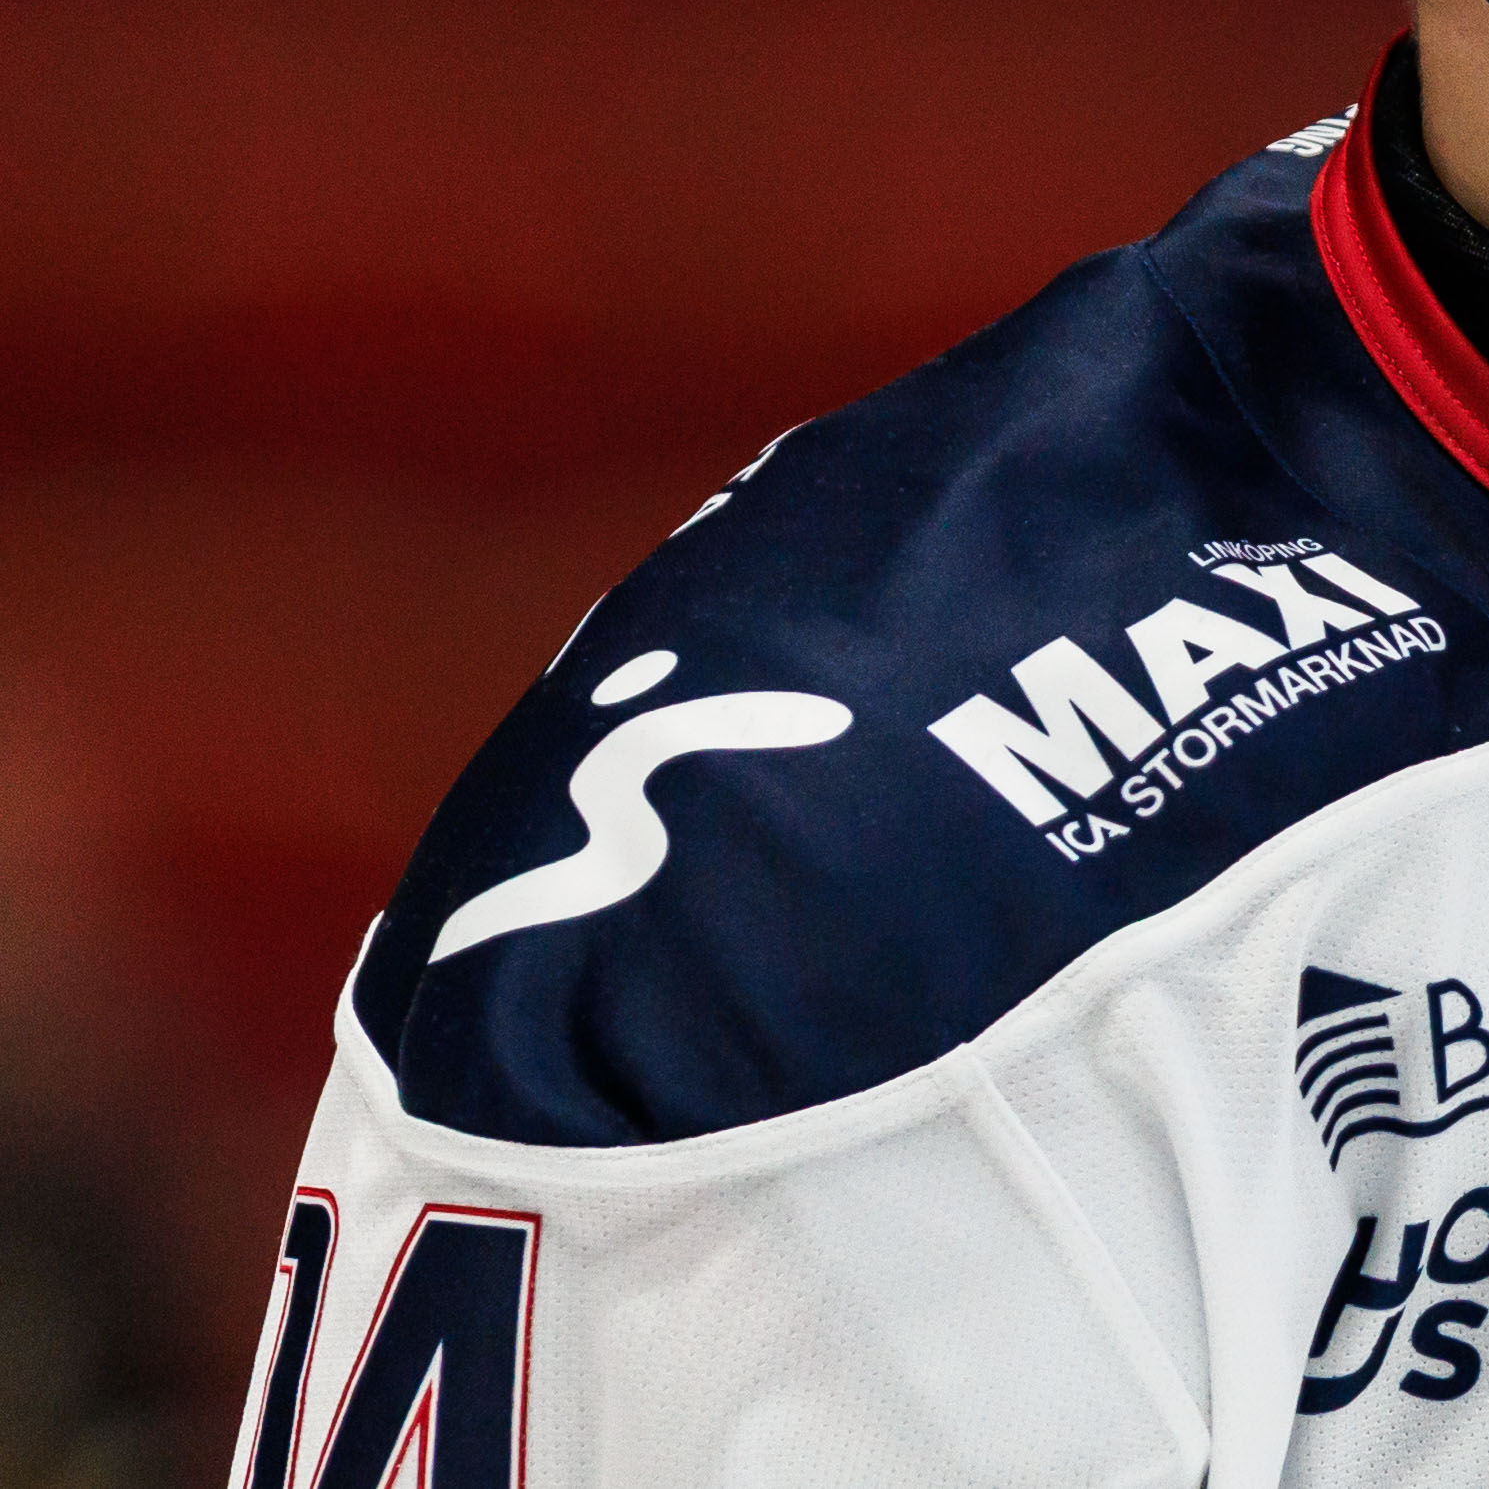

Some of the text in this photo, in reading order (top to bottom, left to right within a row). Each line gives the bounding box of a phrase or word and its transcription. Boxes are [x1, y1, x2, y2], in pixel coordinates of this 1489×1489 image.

[1187, 537, 1324, 568] LINKÖPING
[927, 552, 1422, 828] MAXI
[1044, 615, 1448, 863] ICA STORMARKNAD
